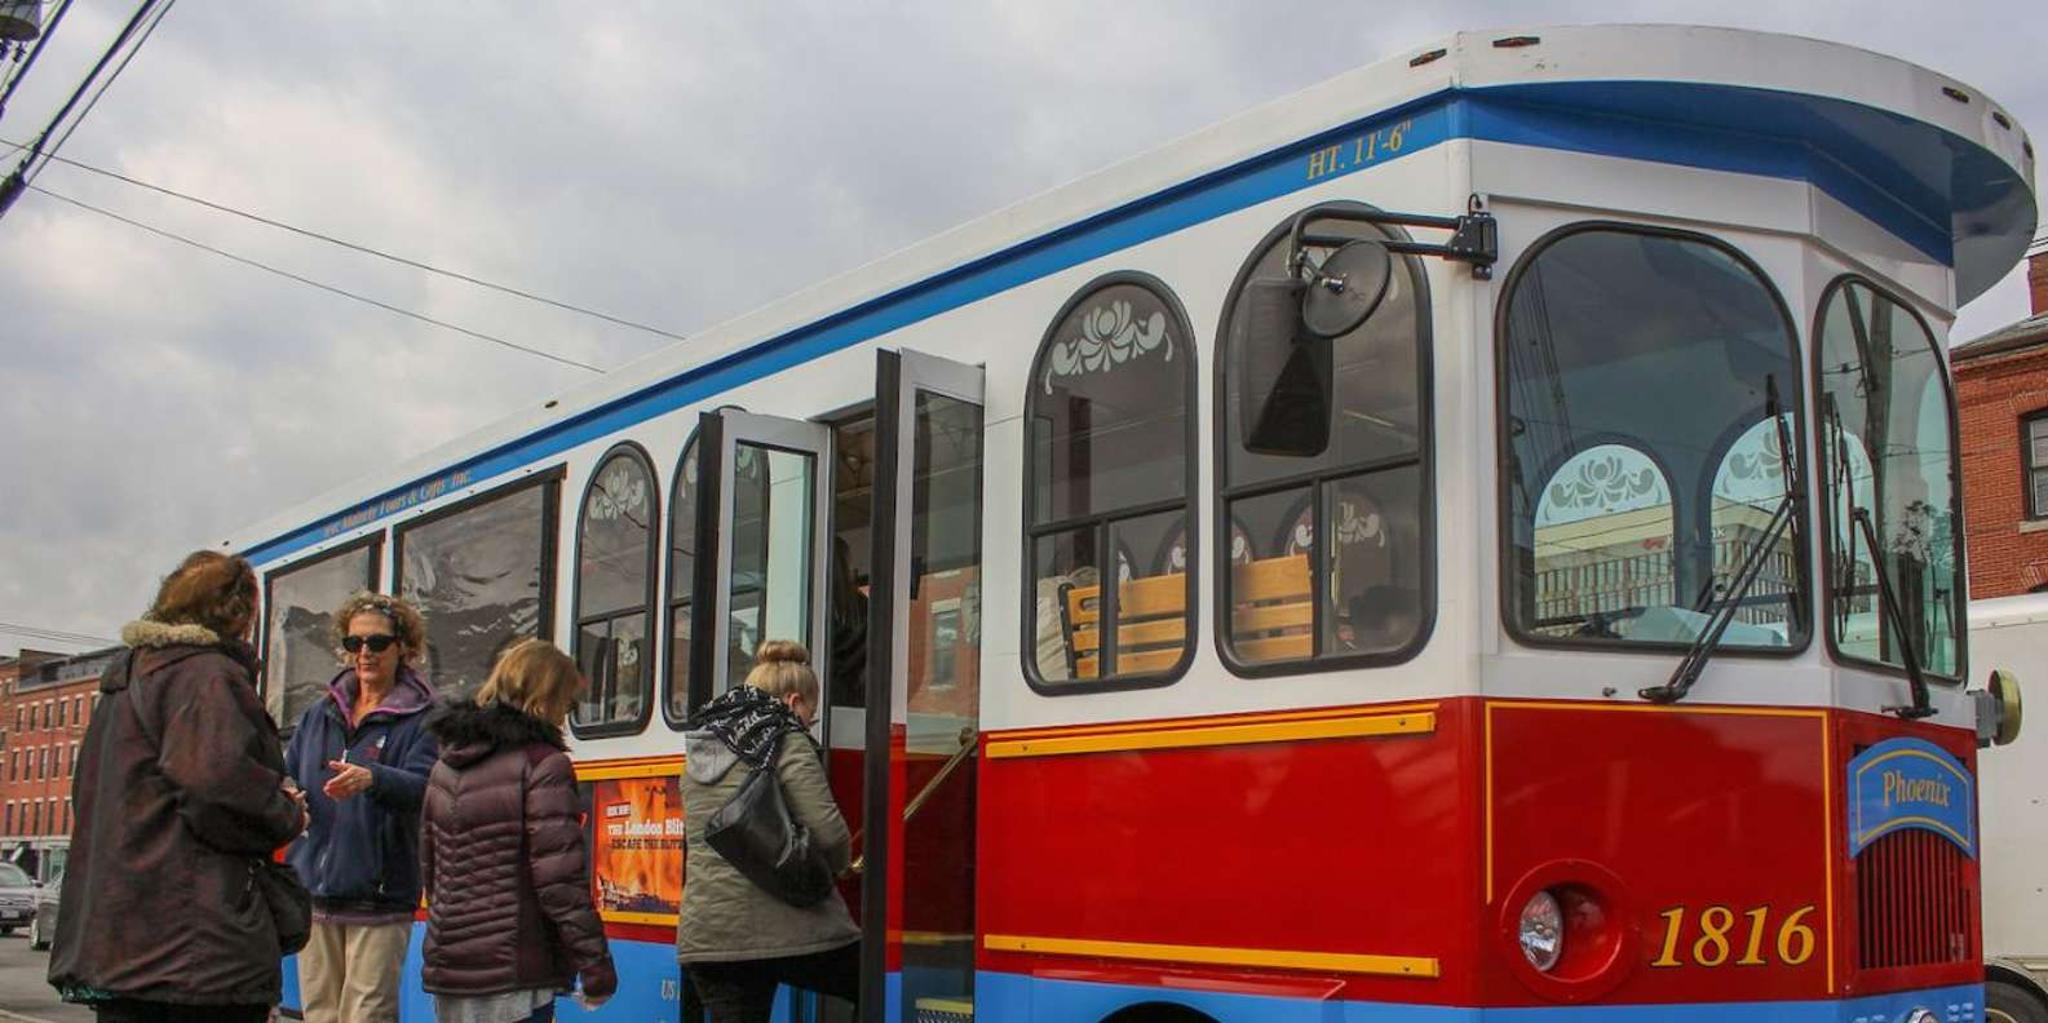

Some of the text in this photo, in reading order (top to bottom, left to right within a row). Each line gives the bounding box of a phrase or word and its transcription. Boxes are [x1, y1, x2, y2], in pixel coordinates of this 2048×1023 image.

[1306, 145, 1345, 180] HT.
[1883, 769, 1951, 808] Phoenix
[666, 818, 684, 835] Blit
[1650, 904, 1816, 967] 1816
